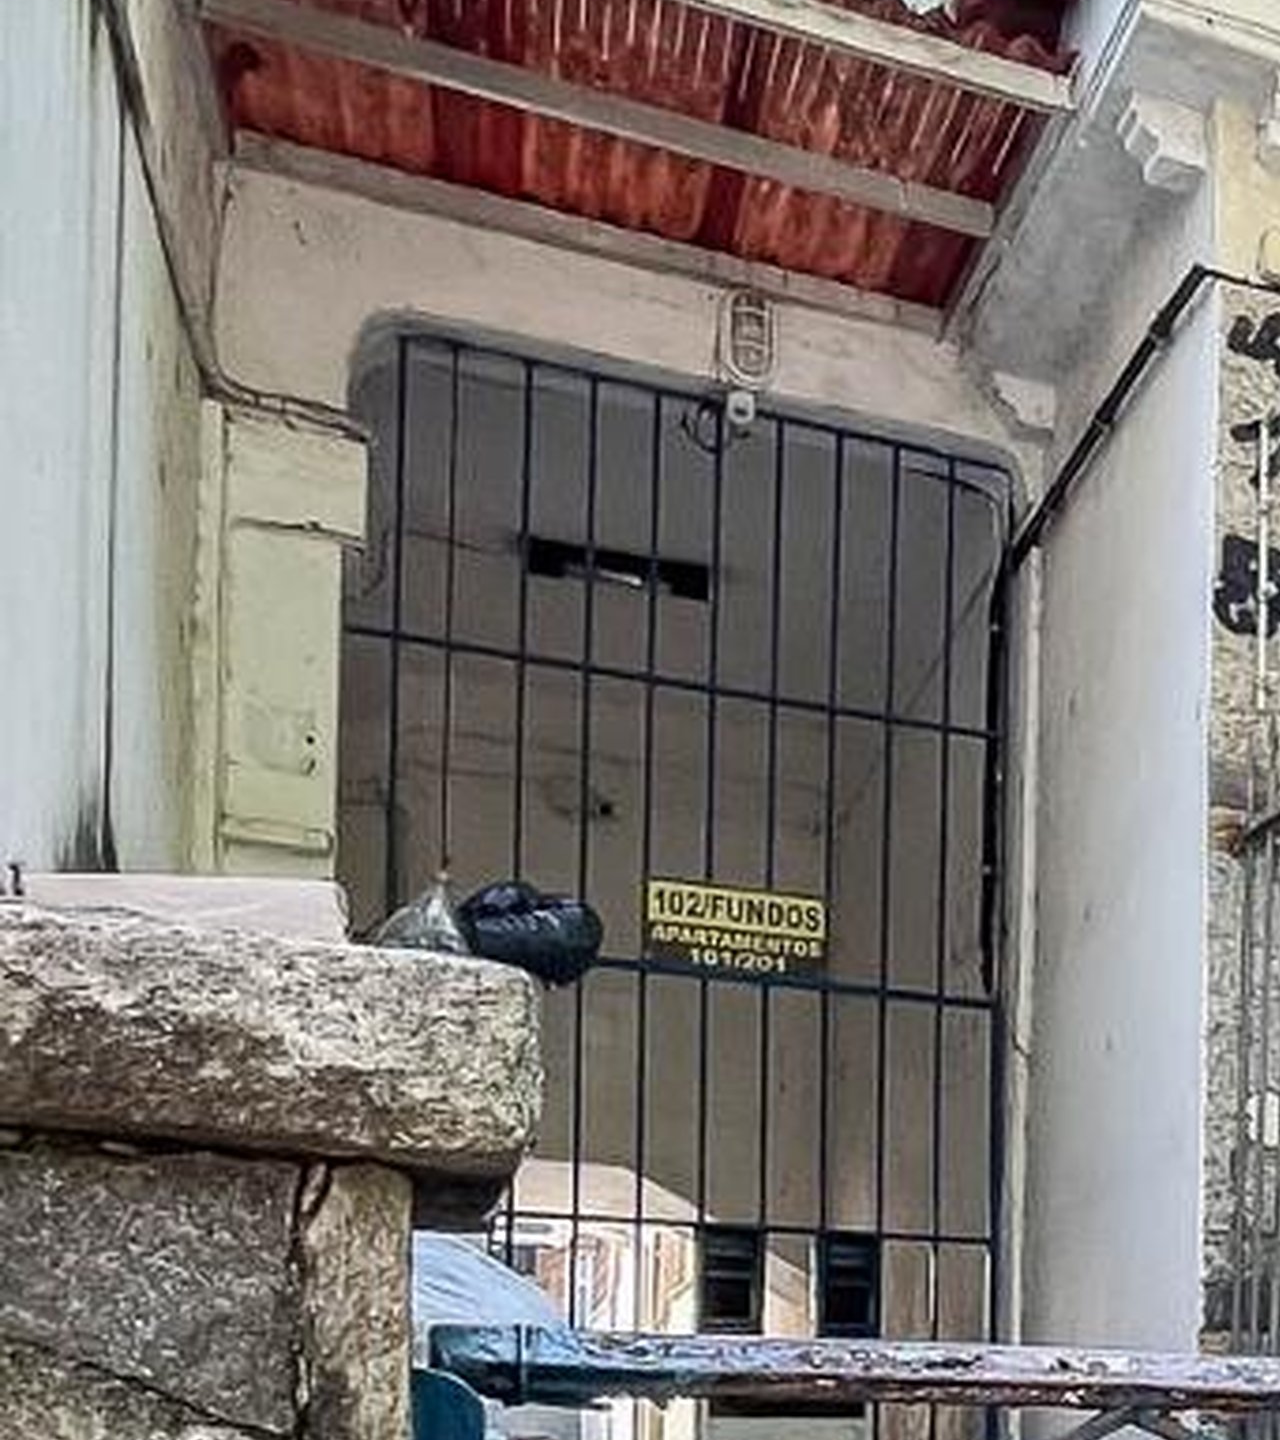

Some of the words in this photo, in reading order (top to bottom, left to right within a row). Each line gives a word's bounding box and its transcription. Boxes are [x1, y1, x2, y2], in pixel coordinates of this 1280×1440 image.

[654, 890, 821, 932] 102/FUNDOS
[652, 924, 823, 958] APARTAMENTOS
[690, 948, 787, 973] 101/201
